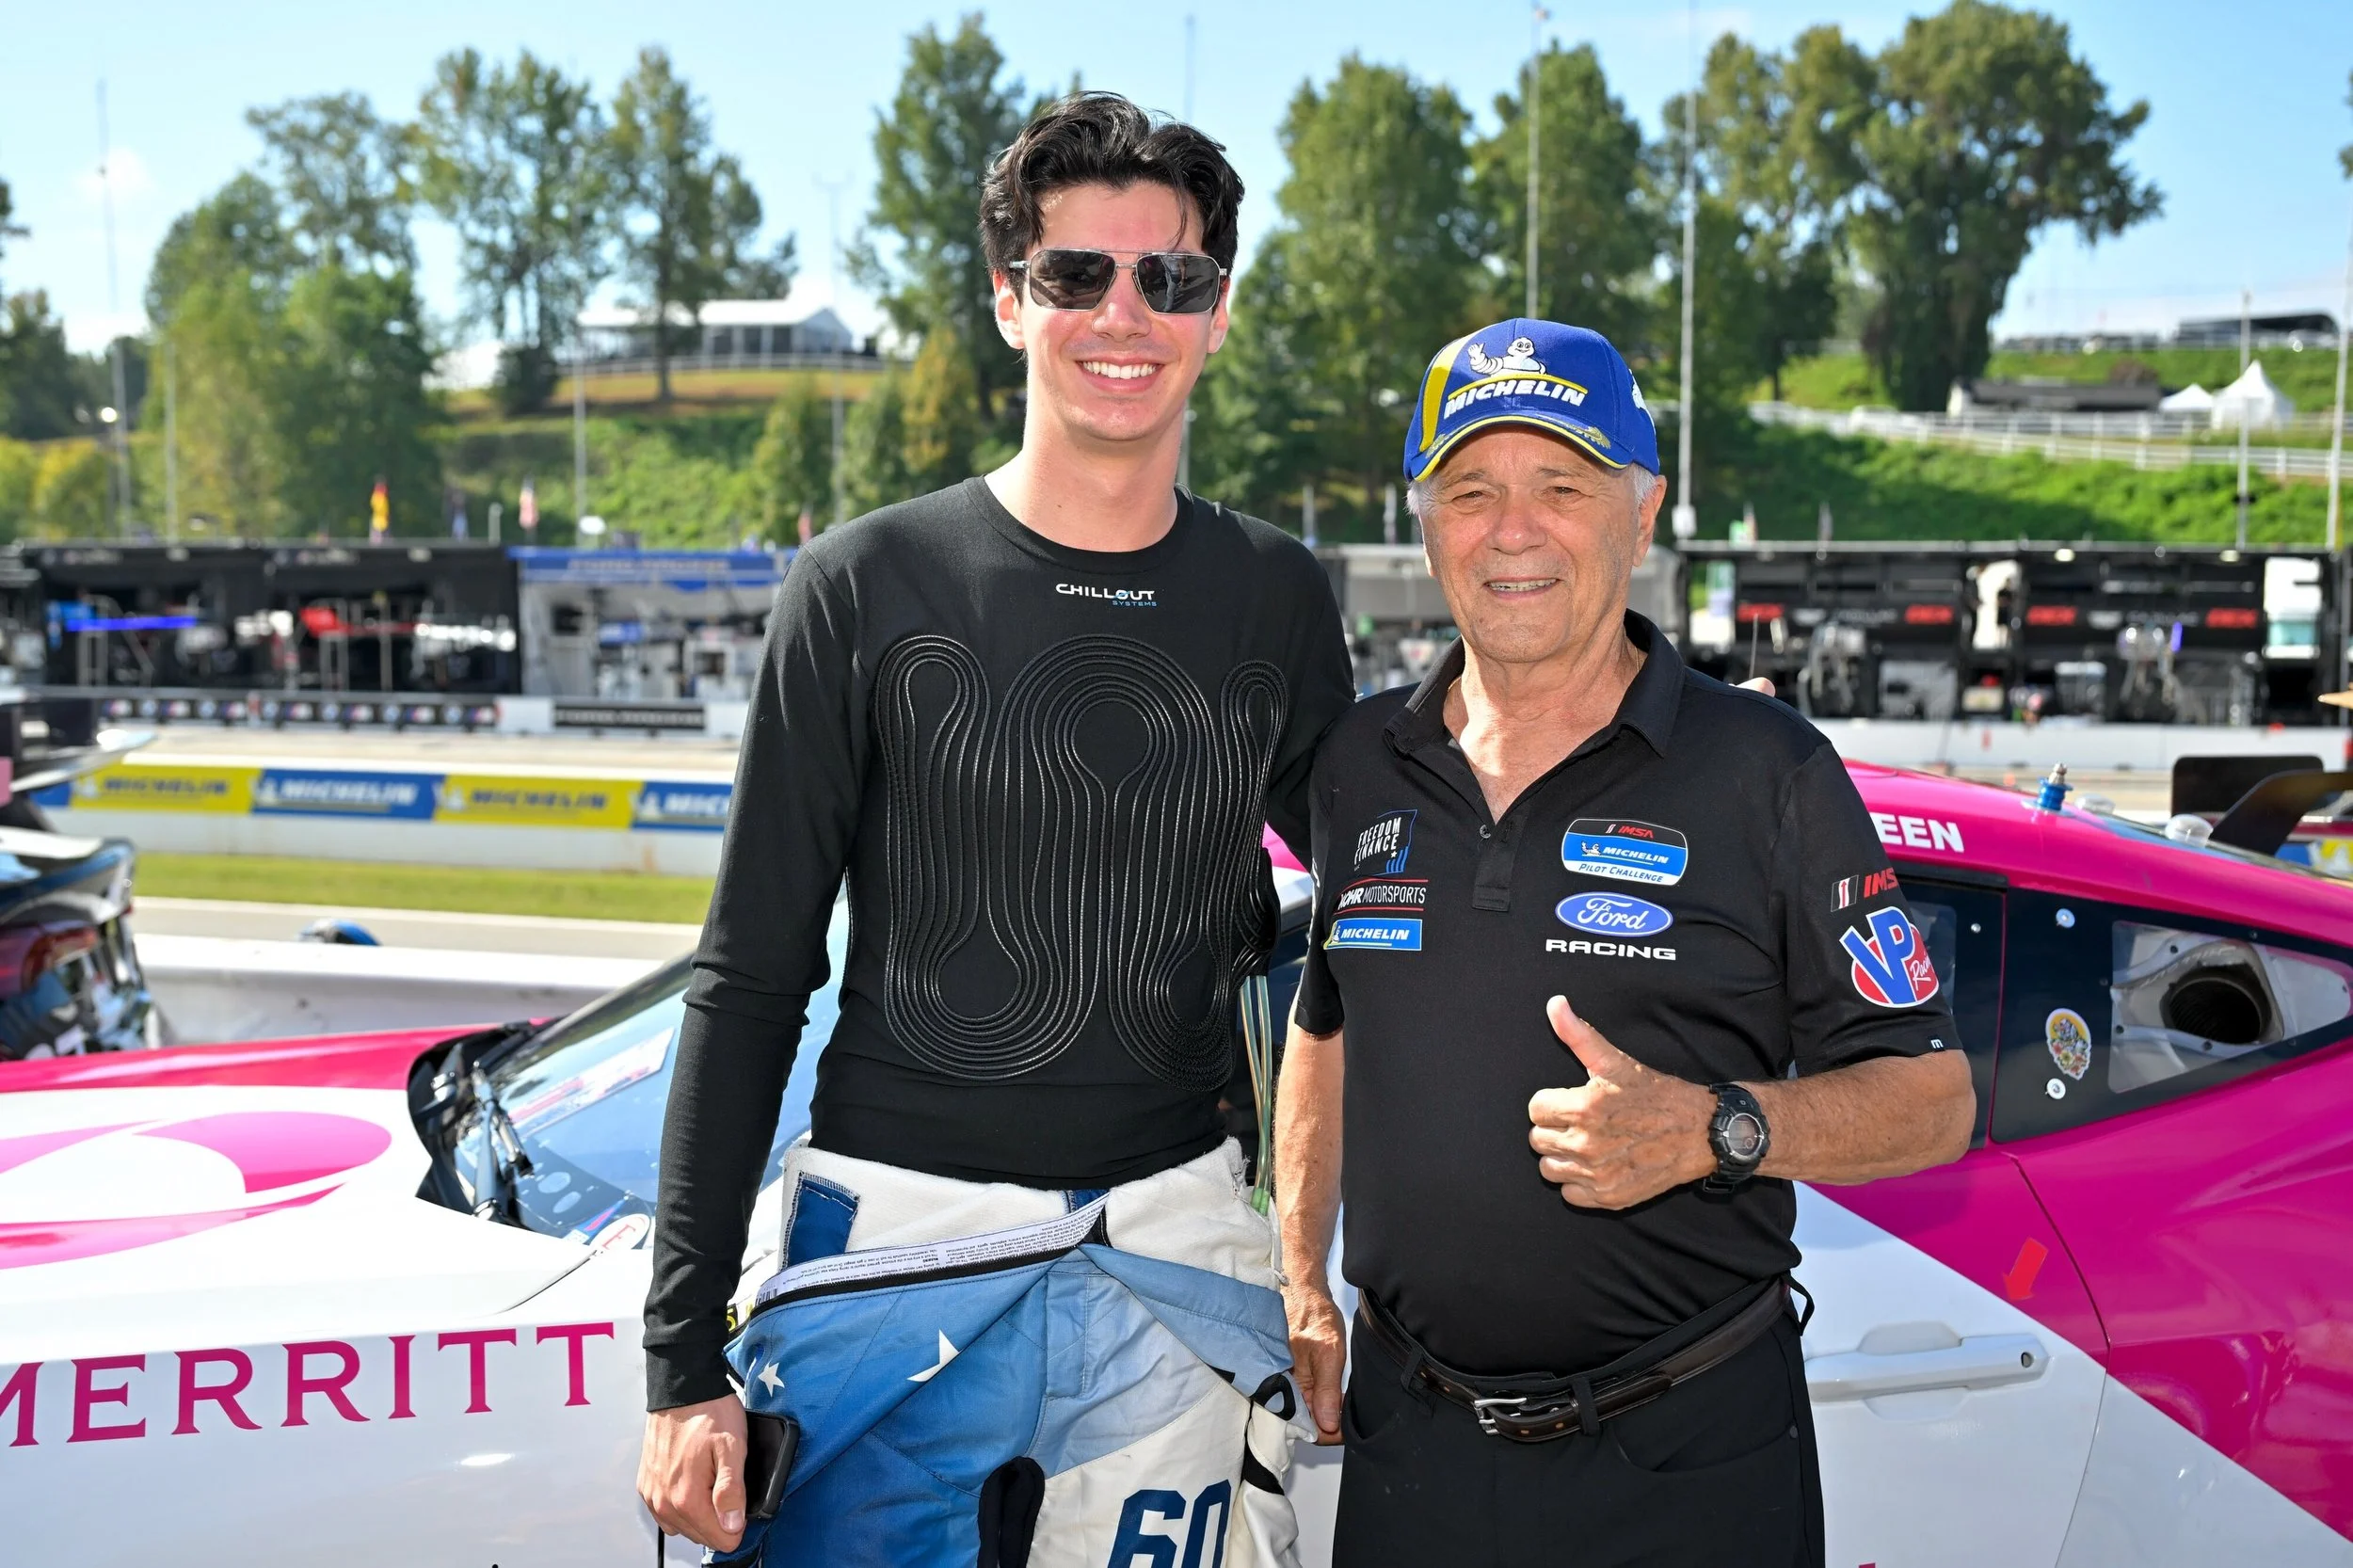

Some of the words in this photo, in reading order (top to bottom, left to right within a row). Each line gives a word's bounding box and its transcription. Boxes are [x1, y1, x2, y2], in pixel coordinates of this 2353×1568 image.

[1444, 380, 1587, 420] MICHELIN
[1055, 583, 1156, 600] CHILLOUT
[102, 776, 228, 797] MICHELIN
[280, 777, 418, 807] MICHELIN
[471, 788, 608, 810] MICHELIN
[1357, 817, 1401, 848] FREEDOM
[1618, 824, 1655, 839] IMSA
[1354, 834, 1400, 865] FINANCE
[1602, 846, 1670, 864] MICHELIN
[1578, 863, 1608, 874] PILOT
[1609, 866, 1664, 883] CHALLENGE
[1577, 897, 1650, 930] Ford
[1340, 928, 1410, 940] MICHELIN
[1545, 938, 1677, 961] RACING
[1839, 905, 1916, 1006] VP
[1107, 1479, 1232, 1568] 60
